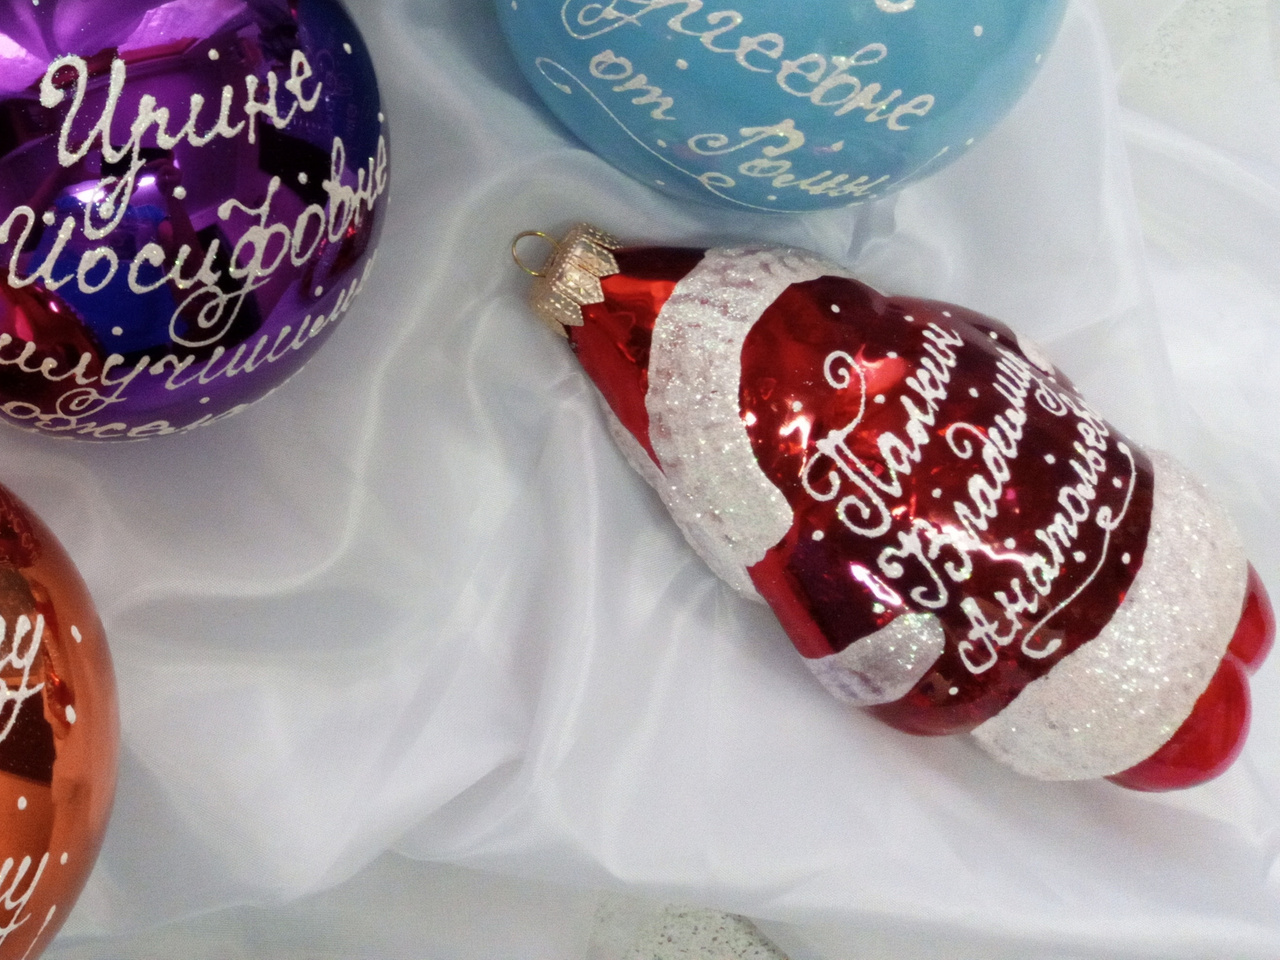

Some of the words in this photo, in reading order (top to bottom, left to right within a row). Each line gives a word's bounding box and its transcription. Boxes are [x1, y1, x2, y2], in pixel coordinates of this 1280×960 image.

[39, 49, 323, 241] Ирине
[588, 49, 676, 120] от
[957, 390, 1112, 675] Анатольев
